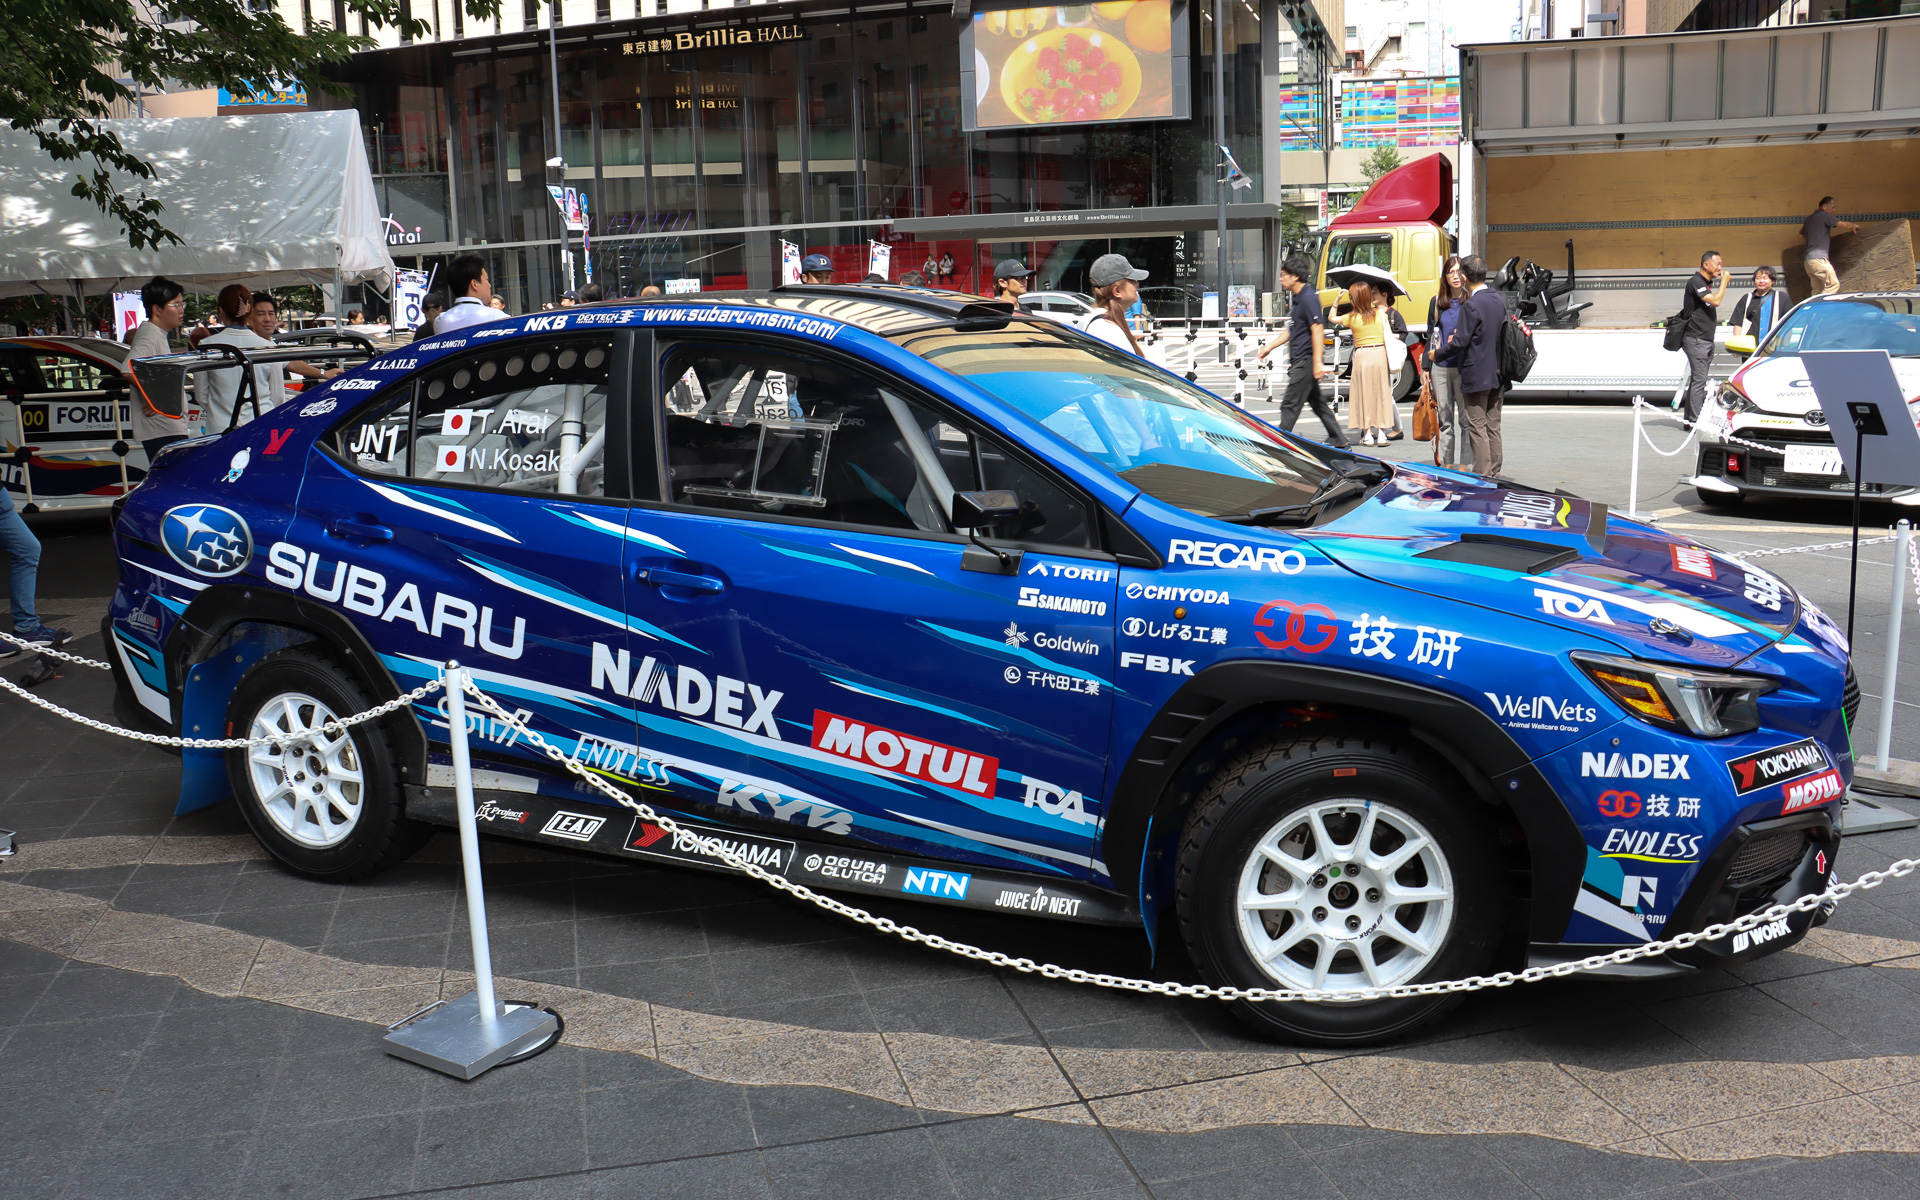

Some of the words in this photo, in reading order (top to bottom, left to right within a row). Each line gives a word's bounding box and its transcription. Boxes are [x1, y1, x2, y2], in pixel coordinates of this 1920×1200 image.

[622, 39, 672, 55] 東京建物
[675, 28, 752, 50] Brillia
[757, 24, 803, 42] HALL
[819, 257, 827, 266] D
[523, 314, 569, 332] NKB
[577, 313, 617, 321] DEXTECH
[643, 306, 846, 341] www.subaru-msm.com/
[441, 339, 467, 349] SANGYO
[380, 358, 418, 370] LAILE
[23, 411, 44, 426] 00
[478, 408, 549, 435] T.Arai
[350, 424, 400, 461] JN1
[1167, 538, 1307, 576] RECARO
[1051, 564, 1110, 582] TORII
[265, 541, 527, 660] SUBARU
[1037, 594, 1107, 616] SAKAMOTO
[1143, 585, 1230, 605] CHIYODA
[1033, 631, 1099, 656] Goldwin
[1148, 621, 1229, 645] しげる工業
[1349, 612, 1464, 671] 技研
[1120, 651, 1197, 677] FBK
[591, 641, 785, 741] NADEX
[1026, 670, 1100, 696] 千代田工業
[1484, 691, 1597, 723] WellVets
[1508, 721, 1531, 729] Animal
[1559, 724, 1579, 733] Group
[571, 734, 676, 786] ENDLESS
[818, 717, 989, 794] MOTUL
[1581, 751, 1691, 780] NADEX
[1756, 745, 1823, 778] YOKOHAMA
[1784, 774, 1843, 811] MOTUL
[490, 806, 525, 818] Project
[1646, 793, 1701, 819] 技研
[549, 814, 598, 836] LEAD
[671, 832, 783, 869] YOKOHAMA
[1601, 828, 1703, 858] ENDLESS
[820, 864, 886, 885] CLUTCH
[825, 854, 888, 875] OGURA
[903, 869, 969, 898] NTN
[995, 889, 1029, 909] JUICE
[1049, 897, 1081, 916] NEXT
[1747, 917, 1792, 947] WORK
